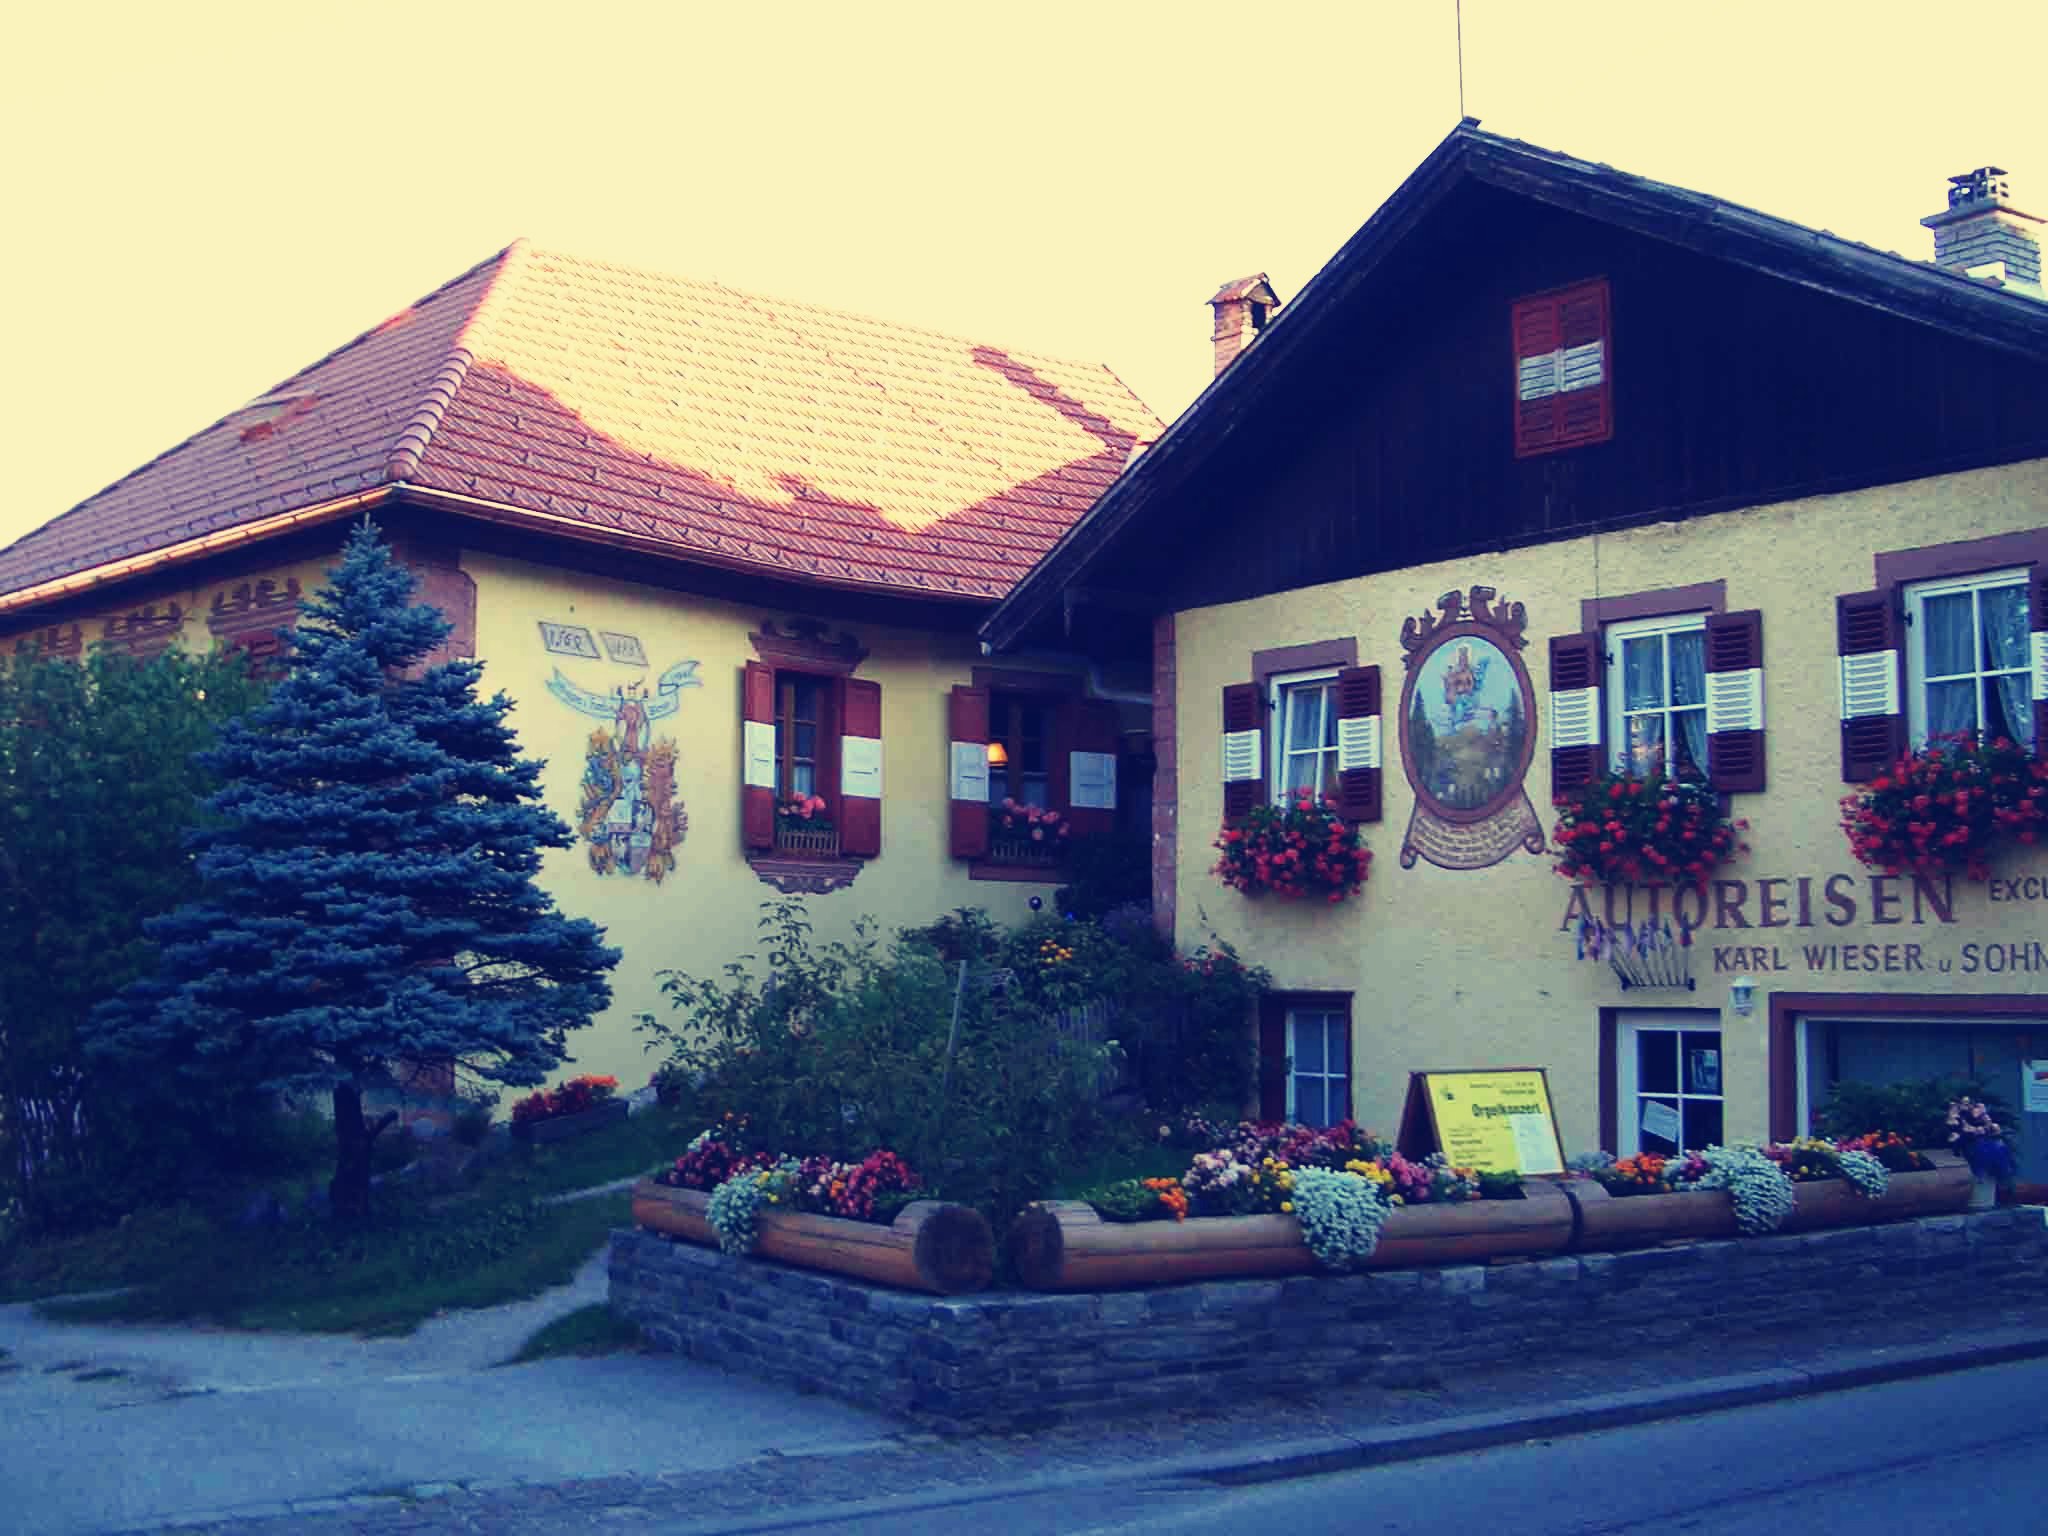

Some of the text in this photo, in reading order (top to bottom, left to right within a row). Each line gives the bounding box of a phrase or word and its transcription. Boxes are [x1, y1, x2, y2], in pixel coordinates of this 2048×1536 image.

[1560, 873, 1960, 931] AUTOREISEN
[1713, 946, 1789, 973] KARL
[1803, 943, 1925, 973] WIESER
